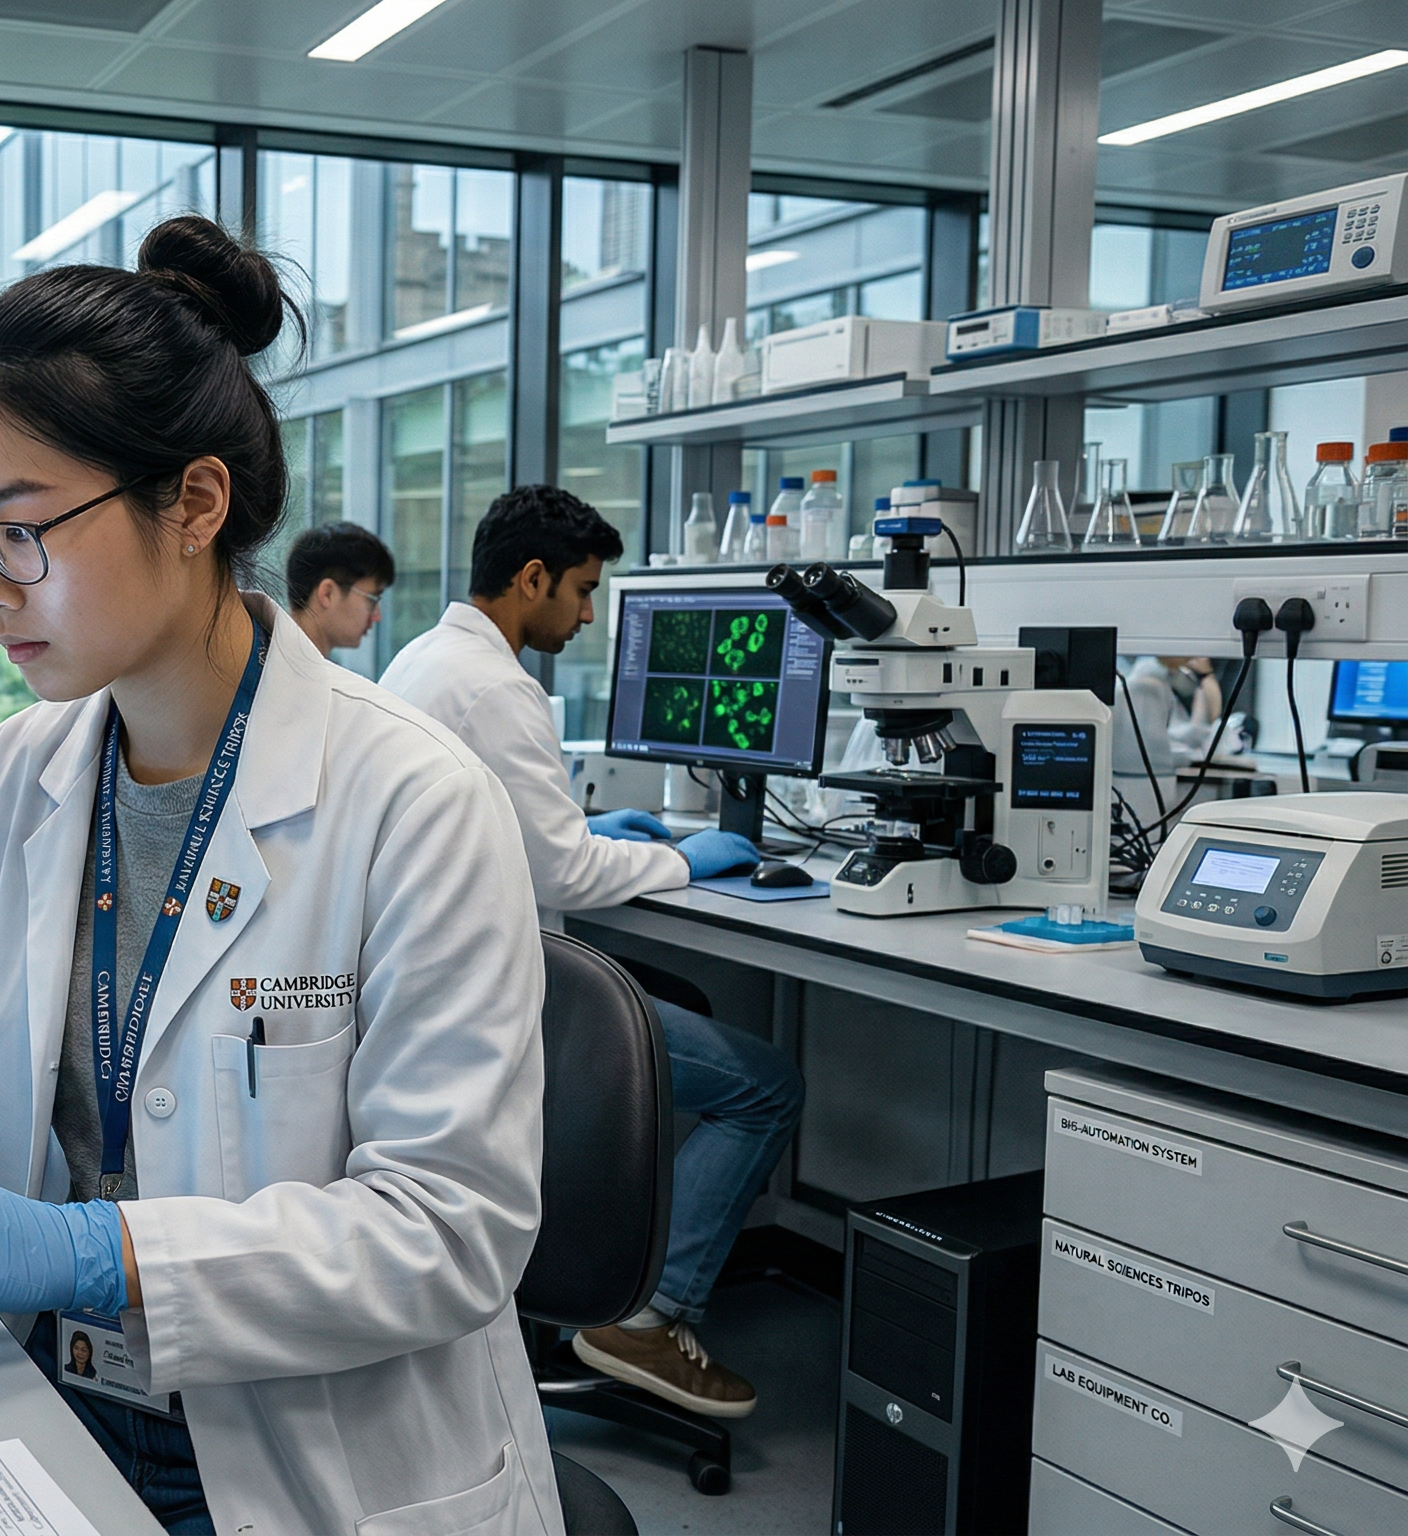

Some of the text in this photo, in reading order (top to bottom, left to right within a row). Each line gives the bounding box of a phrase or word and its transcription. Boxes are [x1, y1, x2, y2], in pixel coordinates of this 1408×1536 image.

[260, 973, 355, 992] CAMBRIDGE
[260, 989, 355, 1010] UNIVERSITY
[1152, 1144, 1197, 1169] SYSTEM
[1055, 1239, 1105, 1268] NATURAL
[1166, 1280, 1210, 1307] TRIPOS
[1052, 1363, 1174, 1428] LAB EQUIPMENT CO.
